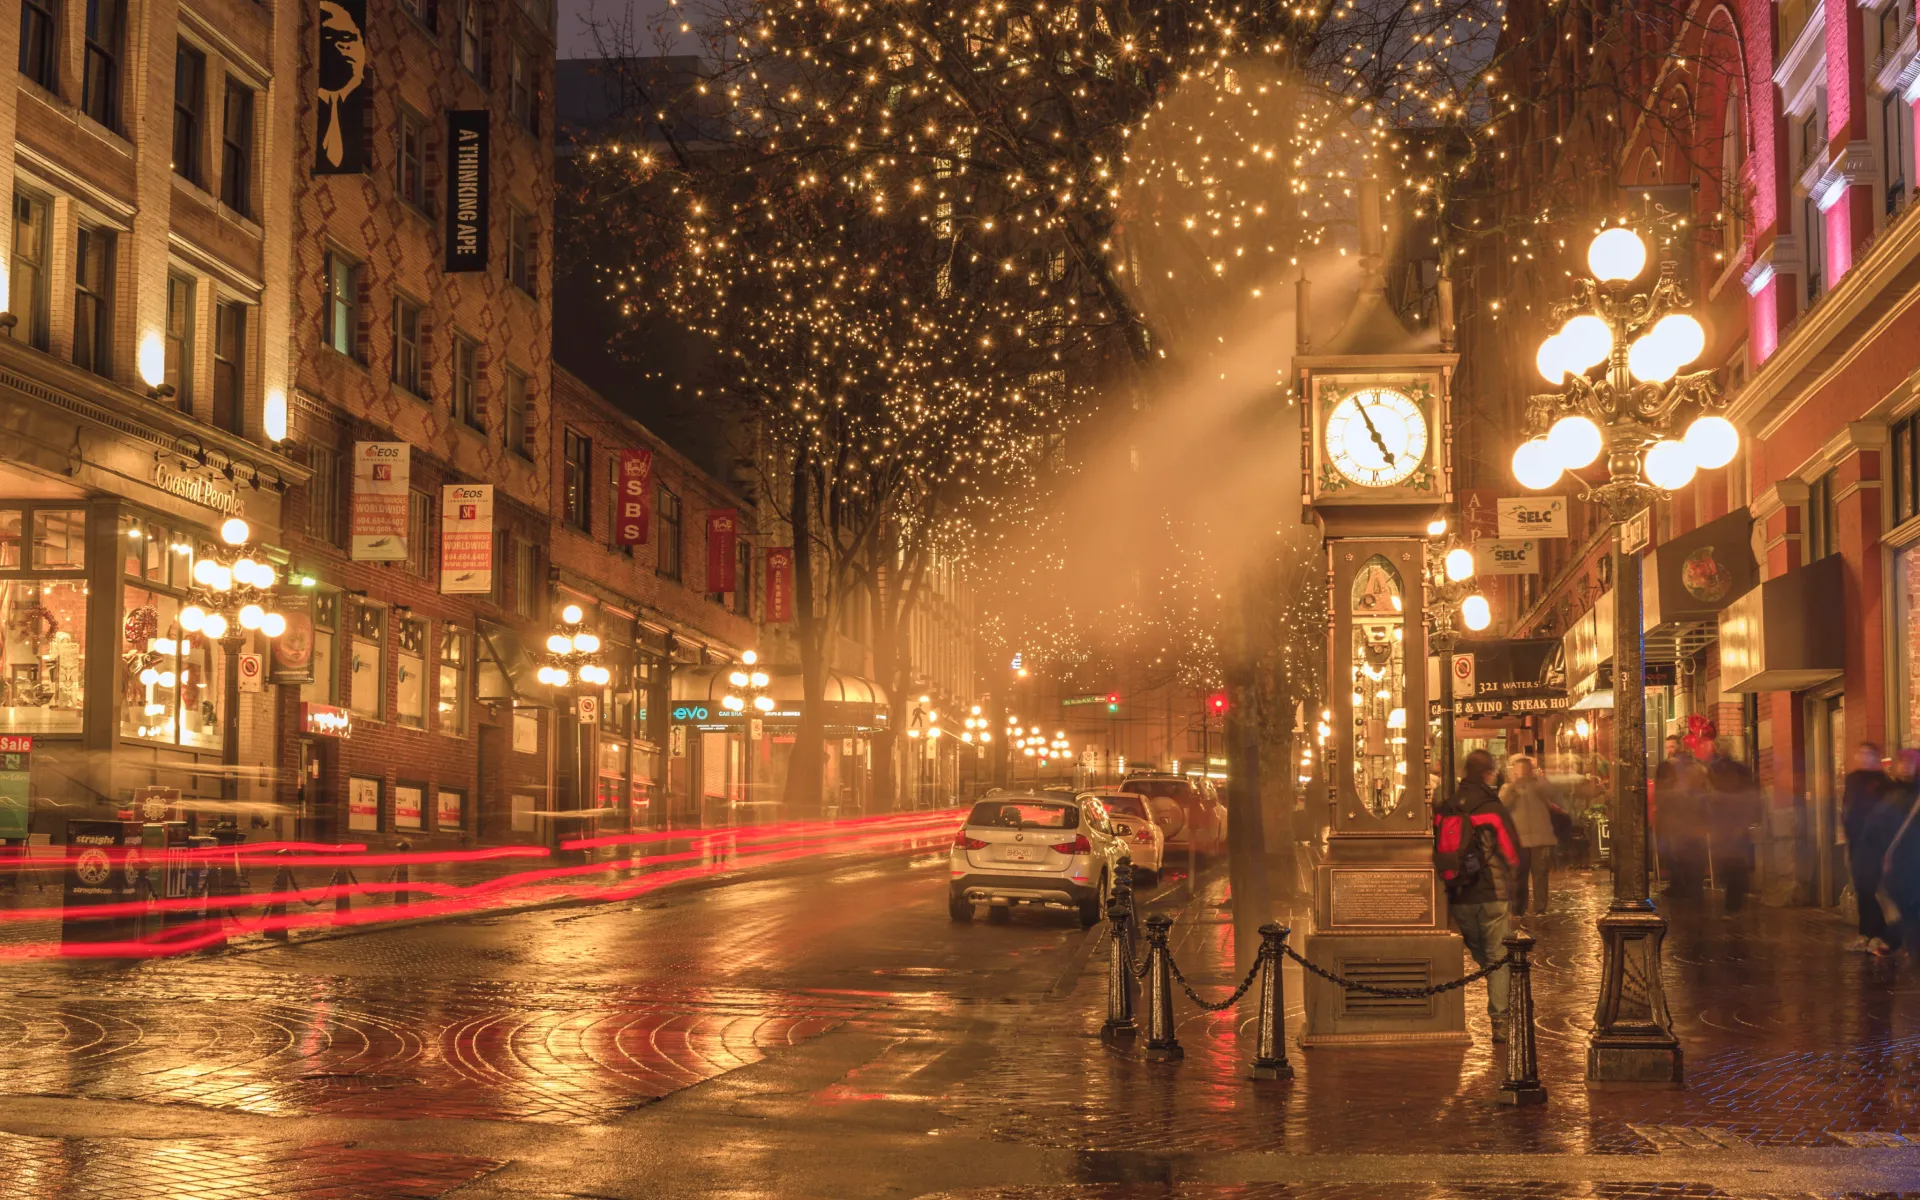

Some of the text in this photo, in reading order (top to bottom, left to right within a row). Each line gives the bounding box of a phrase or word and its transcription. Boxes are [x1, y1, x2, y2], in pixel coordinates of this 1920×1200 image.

[456, 129, 479, 254] A THINKING APE
[365, 445, 398, 458] GEOS
[156, 464, 245, 517] Coastal Peoples
[452, 488, 483, 498] GEOS
[356, 504, 406, 514] WORLDWIDE
[624, 480, 642, 540] SBS
[1518, 511, 1552, 523] SELC
[444, 542, 490, 550] WORLDWIDE
[1494, 550, 1526, 561] SELC
[1478, 682, 1498, 694] 321
[1502, 682, 1532, 690] WATER
[1464, 704, 1474, 713] &
[1476, 702, 1502, 712] VINO
[1512, 699, 1548, 710] STEAK
[673, 706, 708, 720] evo
[0, 738, 30, 751] Sale
[76, 834, 114, 845] straight
